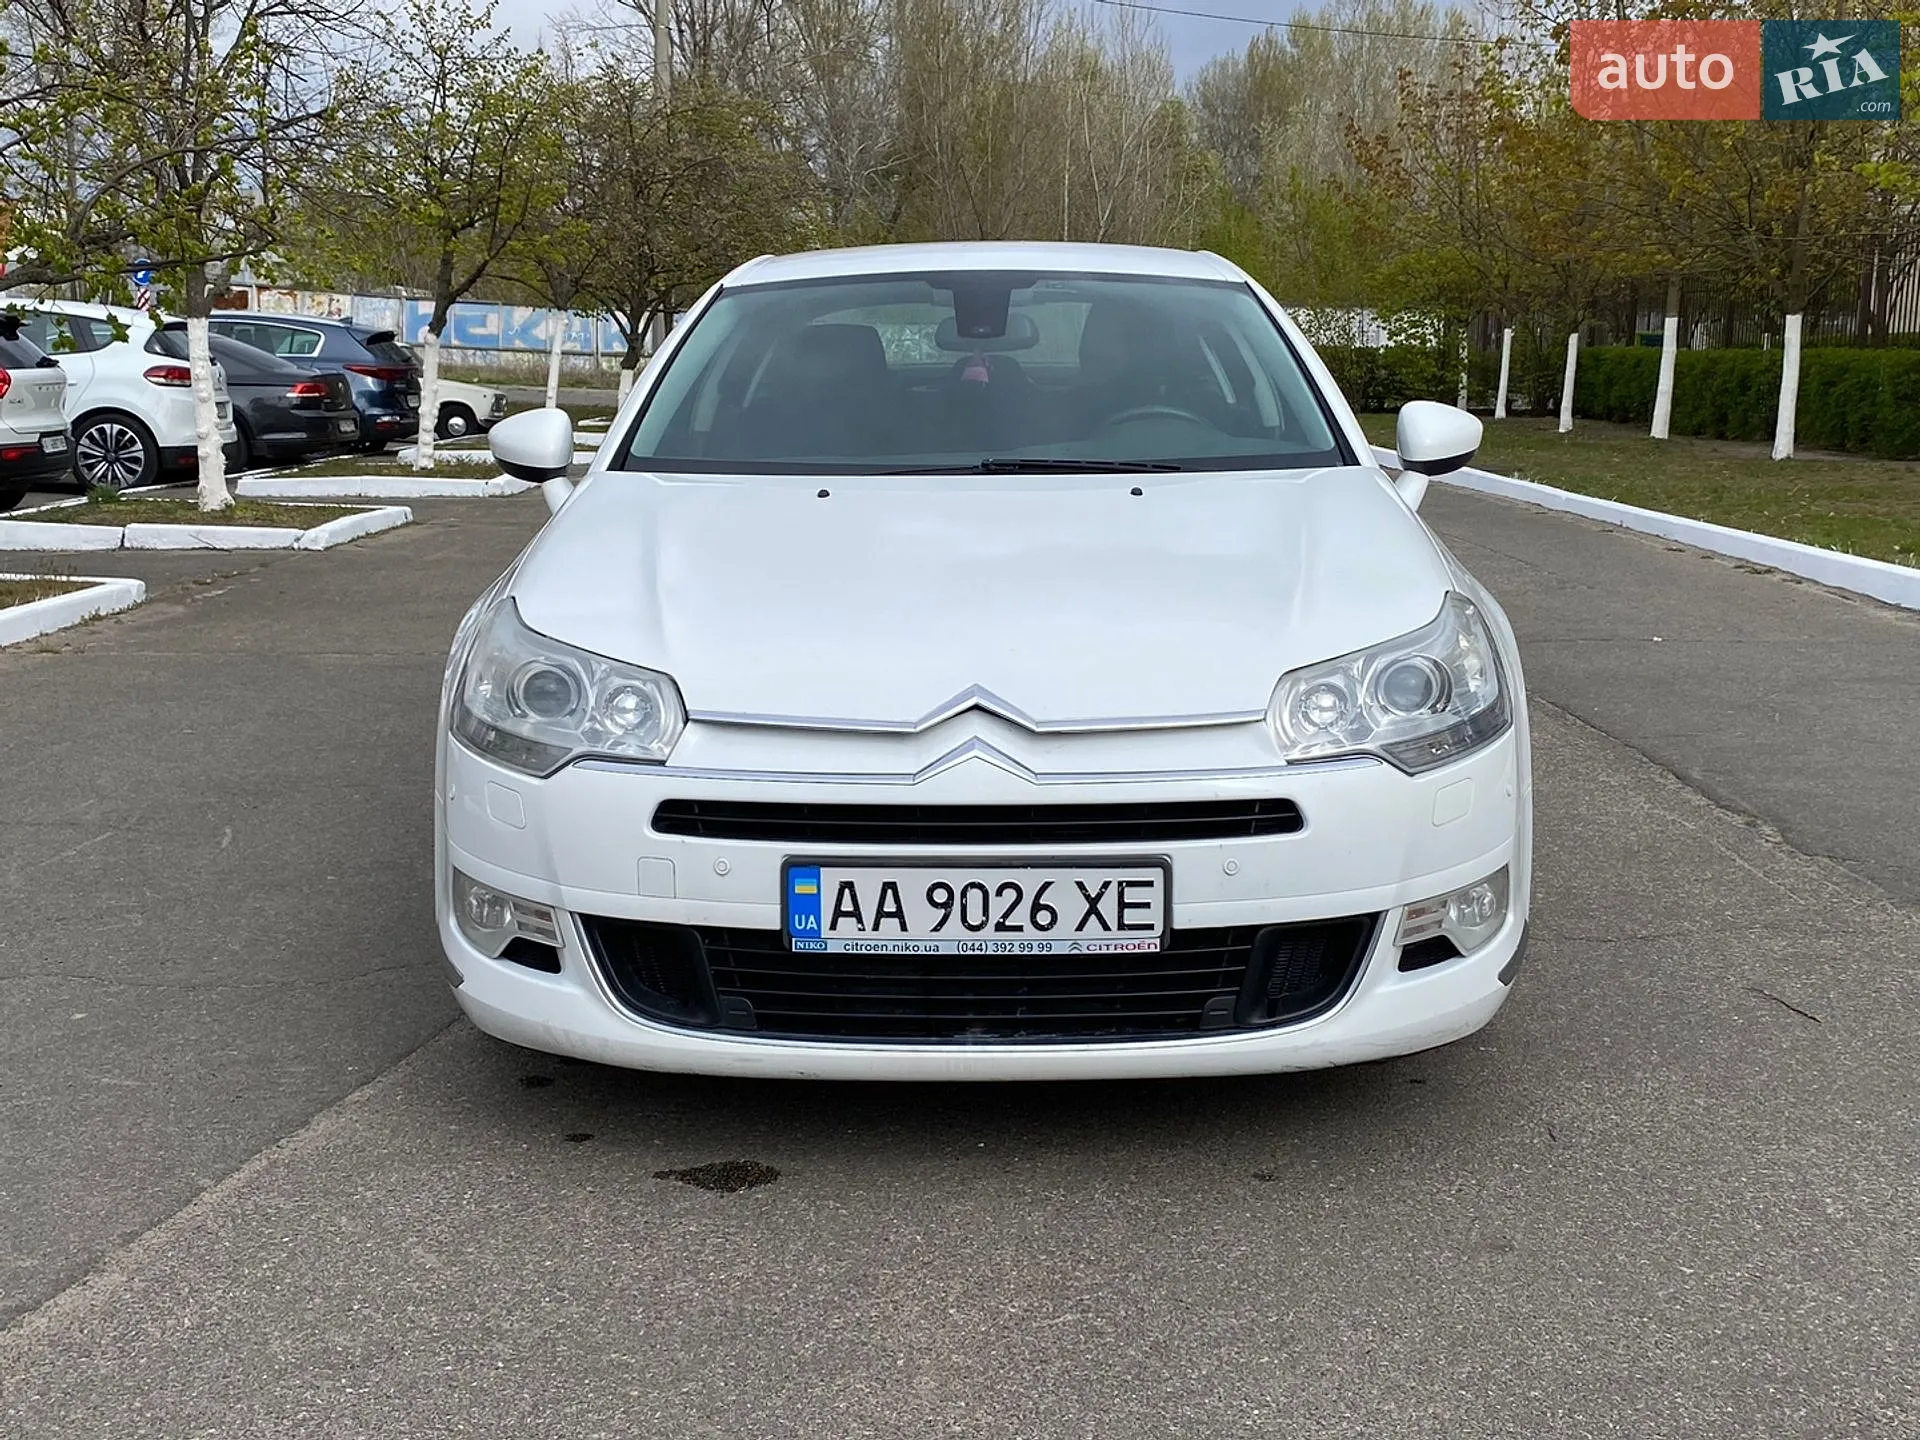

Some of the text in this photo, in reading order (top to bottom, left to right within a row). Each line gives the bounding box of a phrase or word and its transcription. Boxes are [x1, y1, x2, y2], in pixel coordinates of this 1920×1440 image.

[828, 879, 1156, 934] AA 9026 XE
[794, 914, 819, 931] UA
[796, 940, 826, 950] NIKO
[842, 941, 940, 953] citroen.niko.ua
[956, 940, 988, 954] (044)
[992, 942, 1015, 953] 392
[1018, 942, 1034, 953] 99
[1037, 942, 1053, 953] 99
